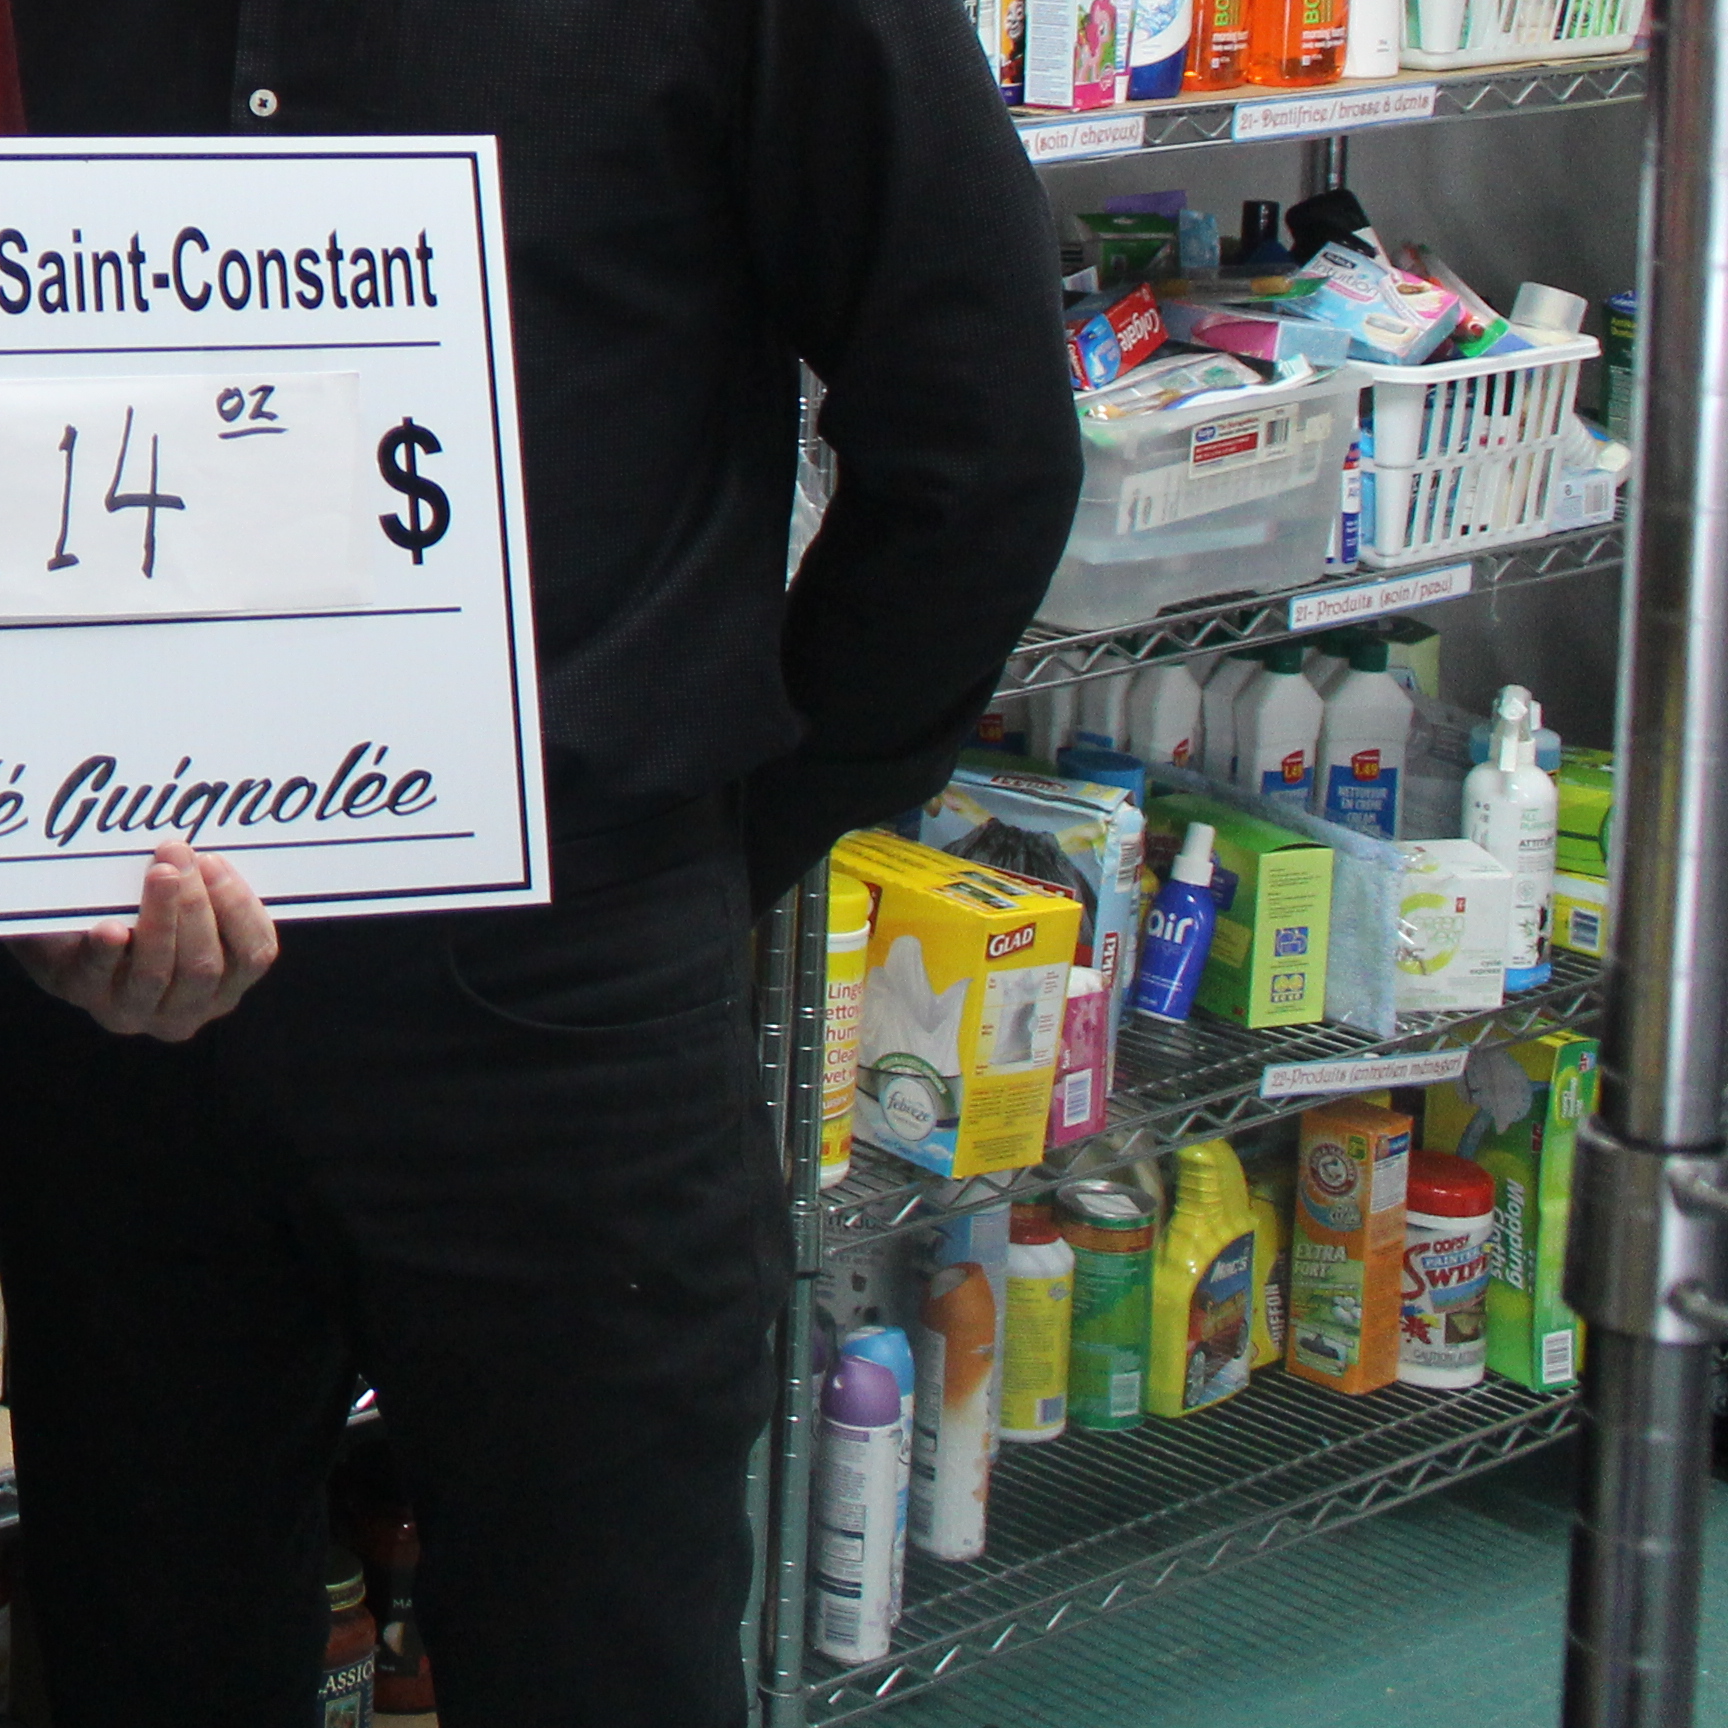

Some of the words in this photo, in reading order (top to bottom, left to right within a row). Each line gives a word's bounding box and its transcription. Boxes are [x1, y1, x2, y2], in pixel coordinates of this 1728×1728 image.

[1262, 106, 1327, 130] Dentifrice
[1120, 307, 1160, 354] Colgate
[376, 416, 452, 566] $
[1316, 594, 1373, 618] Produits
[43, 740, 438, 848] Guignolée
[1147, 907, 1195, 945] air
[989, 927, 1034, 958] GLAD
[886, 1090, 931, 1123] febreze
[1433, 1235, 1470, 1252] OOPS!
[1507, 1178, 1525, 1289] Mopping
[1296, 1245, 1347, 1260] EXTRA
[1295, 1261, 1329, 1277] FORT
